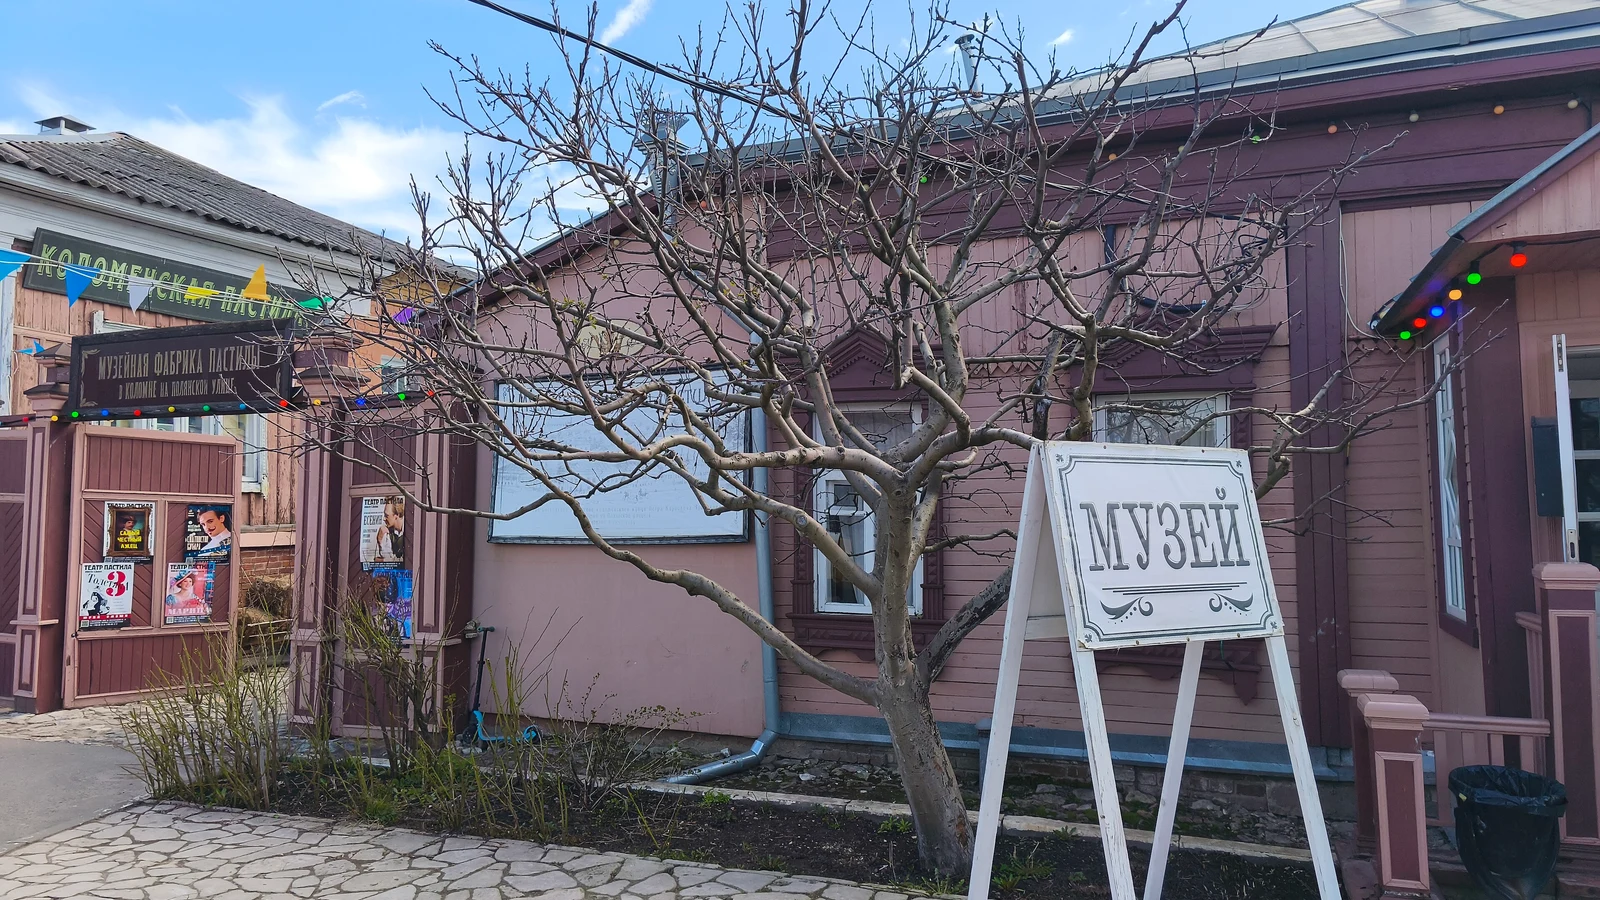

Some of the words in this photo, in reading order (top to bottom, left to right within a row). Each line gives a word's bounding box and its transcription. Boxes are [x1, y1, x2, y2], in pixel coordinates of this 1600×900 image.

[98, 351, 149, 380] МУЗЕЙНАЯ
[154, 349, 203, 376] ФАБРИКА
[209, 345, 260, 373] ПАСТИЛЫ
[125, 380, 157, 400] КОЛОМНЕ
[364, 514, 383, 526] ЕСЕНИН
[1079, 486, 1251, 571] МУЗЕЙ
